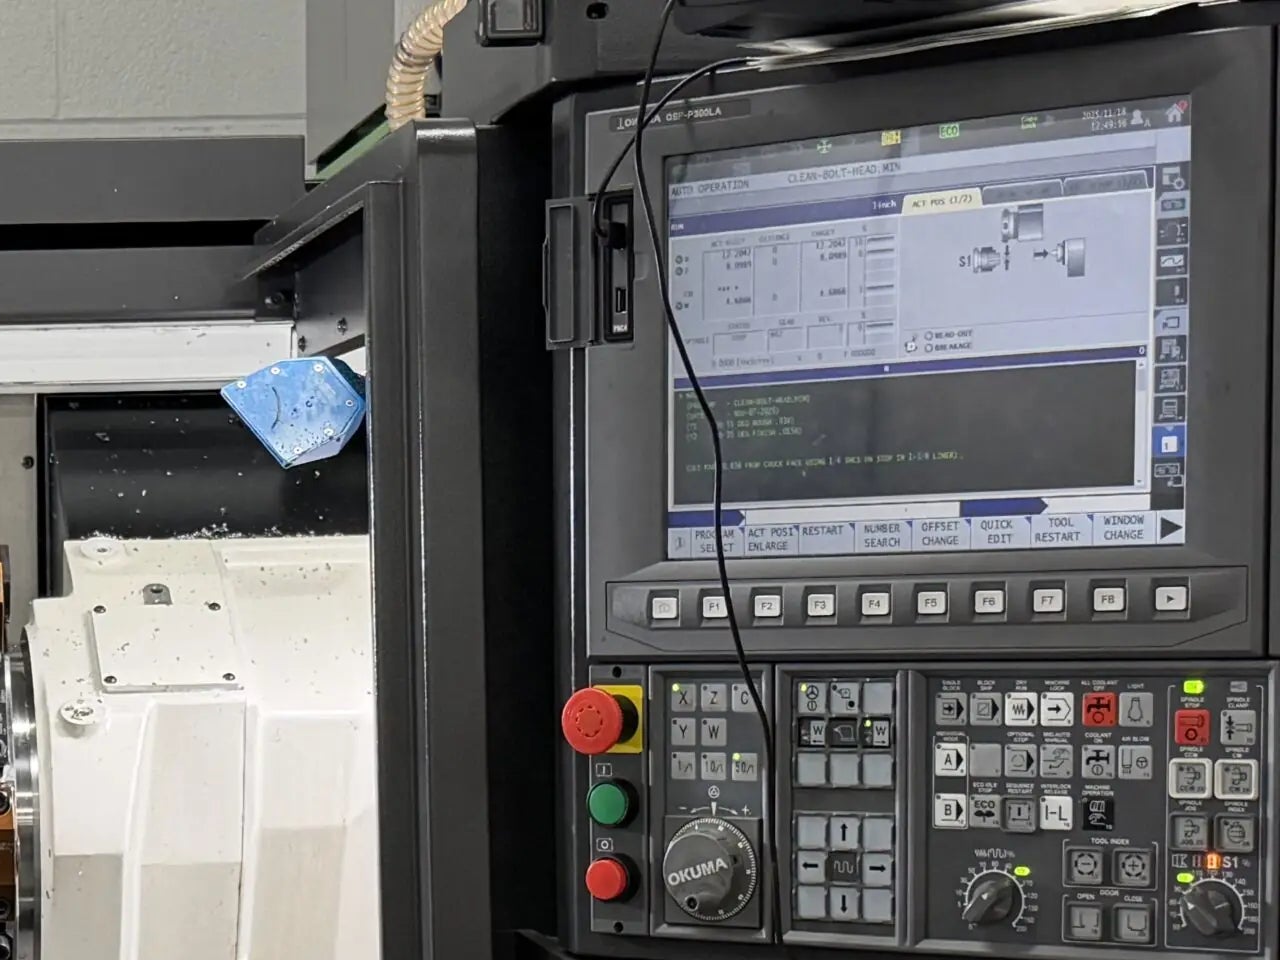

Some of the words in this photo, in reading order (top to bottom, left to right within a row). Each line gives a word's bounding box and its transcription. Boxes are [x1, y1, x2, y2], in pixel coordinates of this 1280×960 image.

[941, 125, 958, 137] ECO
[698, 180, 749, 194] OPERATION
[959, 256, 970, 267] S1
[980, 520, 1012, 531] QUICK
[1049, 518, 1074, 528] TOOL
[1104, 515, 1144, 526] WINDOW
[802, 525, 844, 535] RESTART
[864, 523, 900, 533] NUMBER
[922, 522, 960, 532] OFFSET
[748, 529, 765, 538] ACT
[1035, 532, 1080, 542] RESTART
[1104, 530, 1144, 540] CHANGE
[864, 538, 900, 547] SEARCH
[922, 536, 959, 546] CHANGE
[988, 534, 1012, 544] EDIT
[748, 542, 788, 551] ENLARGE
[869, 600, 880, 608] F4
[924, 599, 937, 608] F5
[982, 598, 996, 606] F6
[1042, 596, 1054, 605] F7
[1102, 595, 1115, 604] F8
[761, 602, 772, 610] F2
[815, 601, 826, 609] F3
[680, 692, 688, 704] X
[710, 692, 718, 704] Z
[741, 692, 749, 705] C
[679, 725, 687, 738] Y
[709, 727, 719, 738] W
[813, 726, 823, 735] W
[876, 726, 886, 736] W
[945, 754, 952, 765] A
[945, 804, 951, 815] B
[1223, 856, 1238, 868] S1
[668, 858, 728, 886] OKUMA
